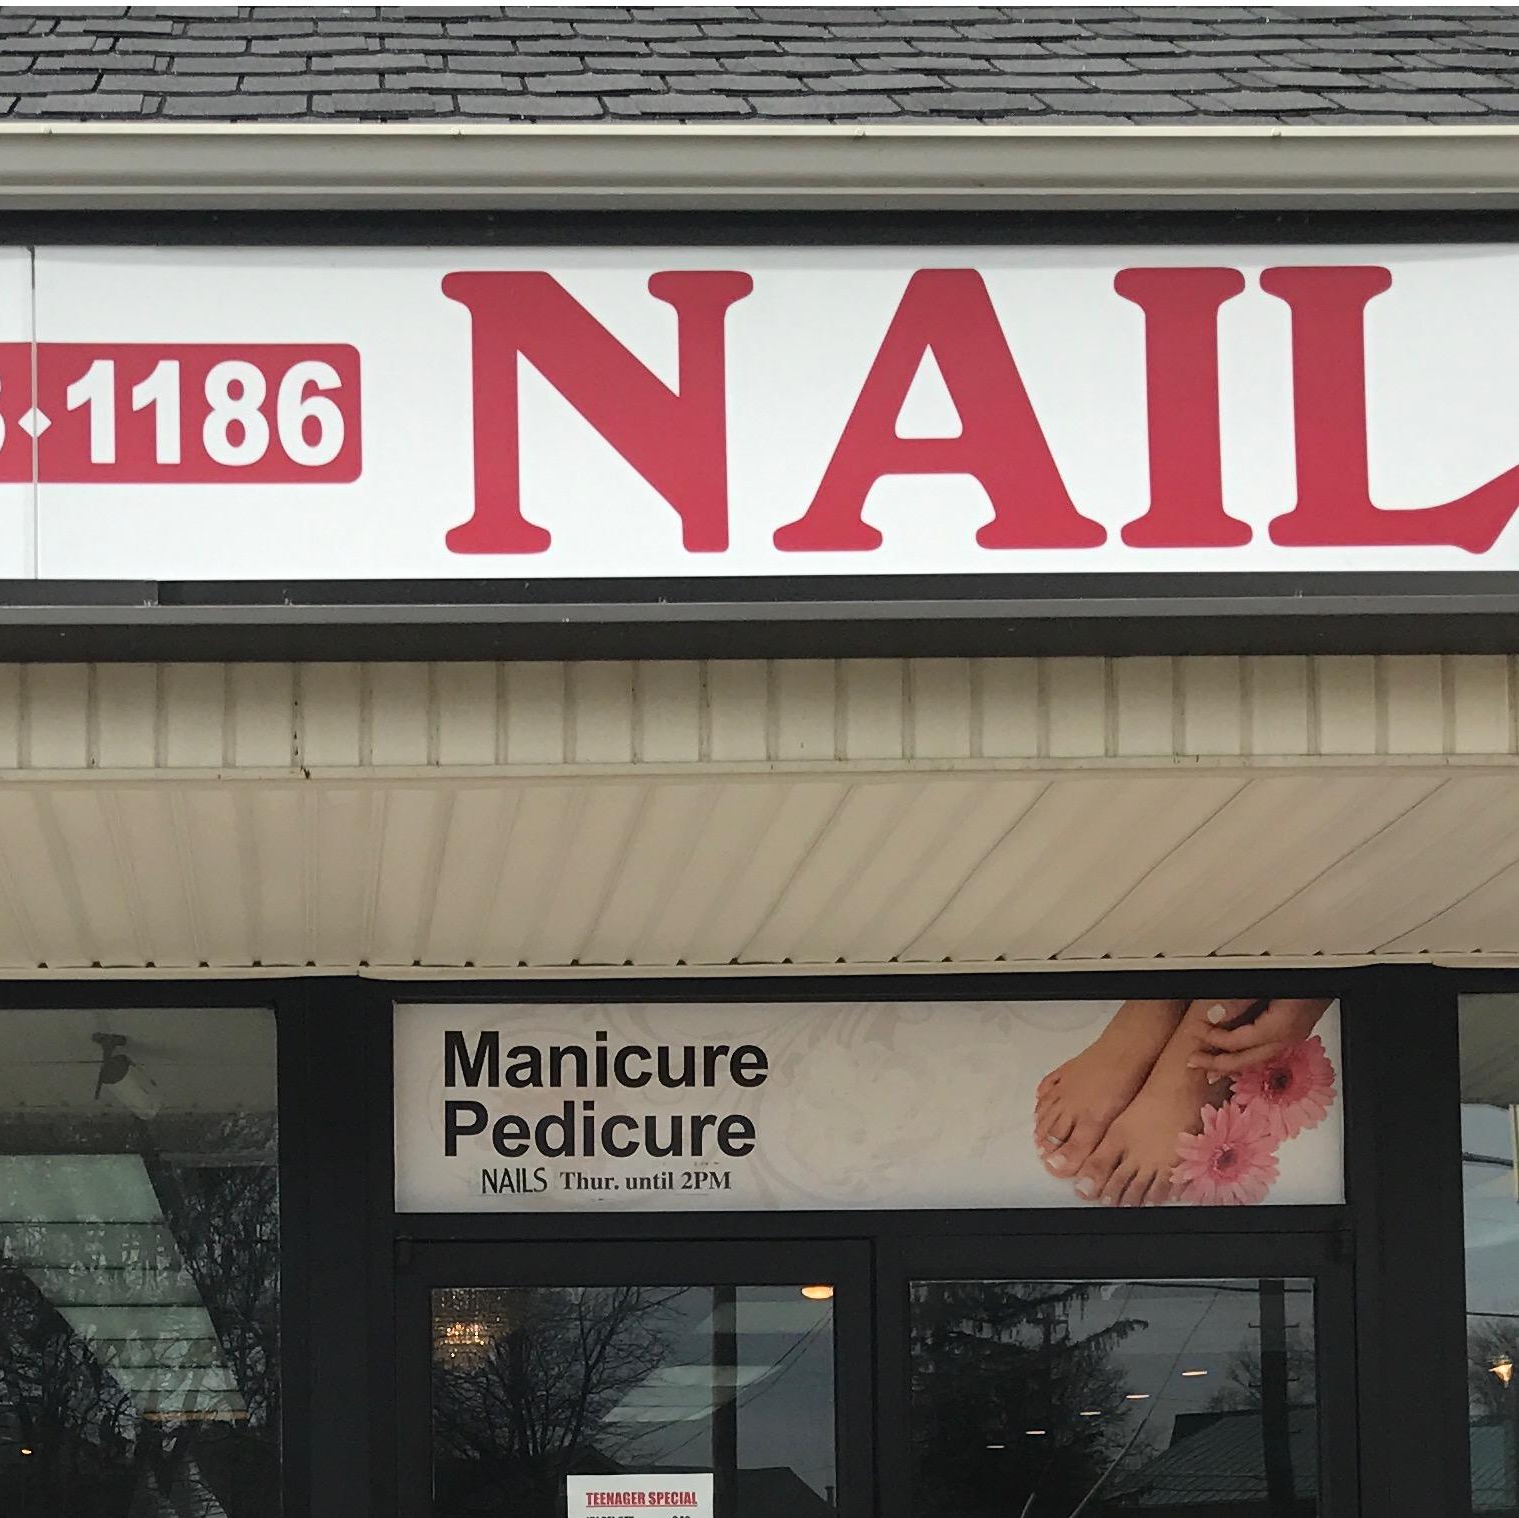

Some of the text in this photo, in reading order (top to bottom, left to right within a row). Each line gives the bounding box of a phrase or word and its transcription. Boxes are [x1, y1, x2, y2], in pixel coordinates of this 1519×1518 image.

[444, 1030, 769, 1089] Manicure
[444, 1100, 756, 1158] Pedicure
[482, 1166, 731, 1194] NAILS Thur. until 2PM
[585, 1491, 698, 1506] TEENAGER SPECIAL
